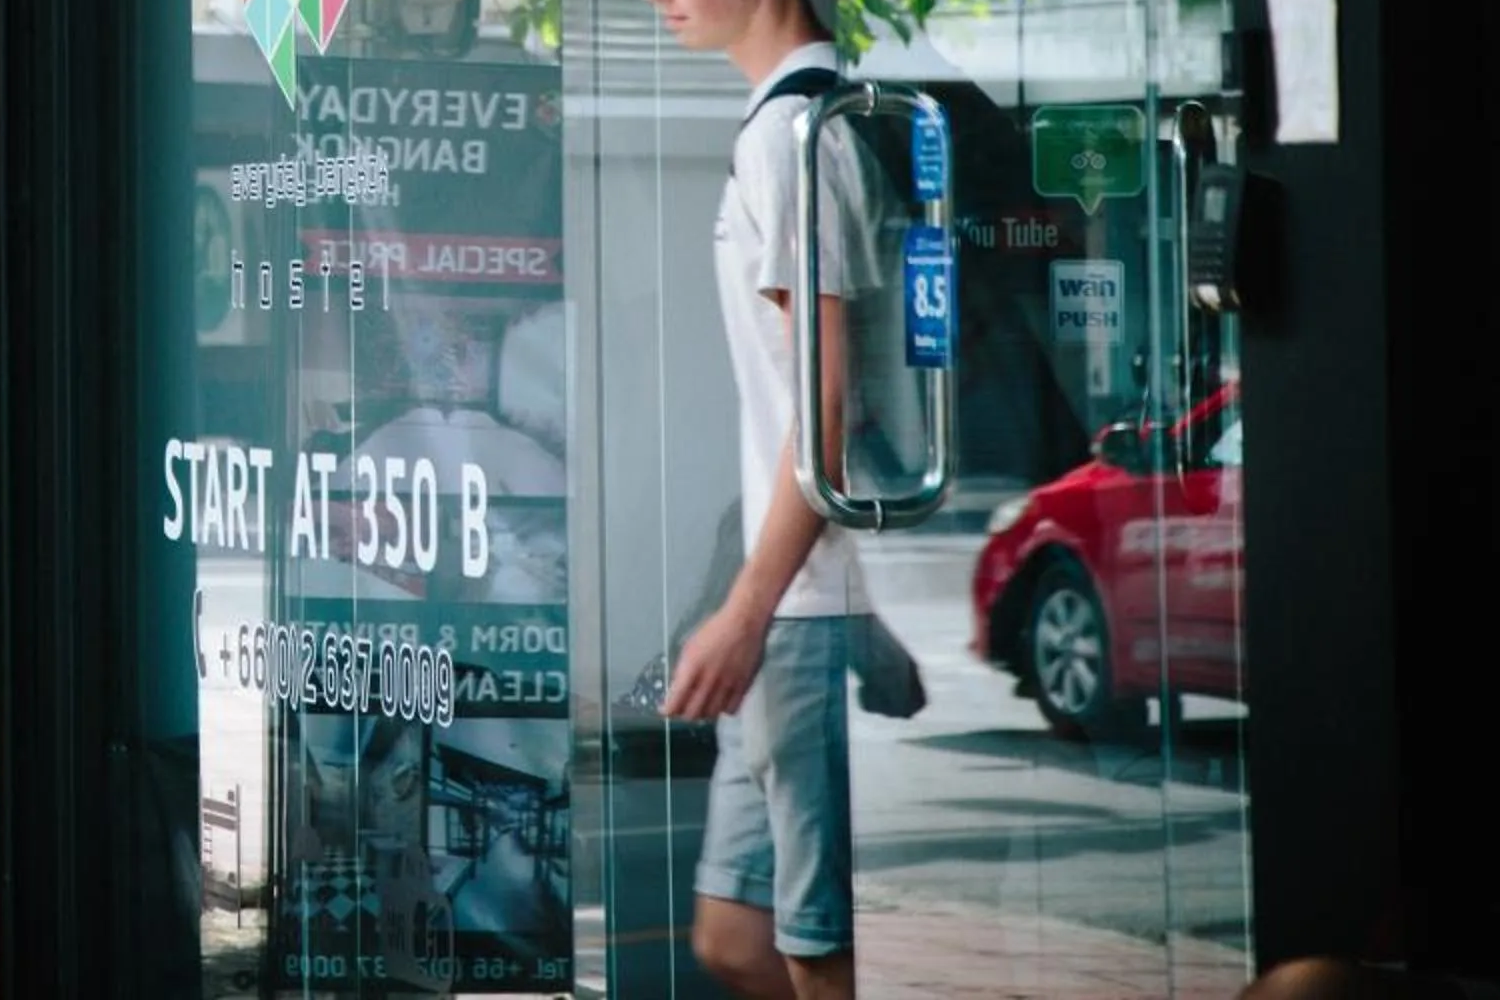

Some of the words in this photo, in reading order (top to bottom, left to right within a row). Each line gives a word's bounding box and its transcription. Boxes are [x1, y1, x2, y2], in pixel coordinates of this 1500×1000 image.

[1001, 215, 1060, 248] Tube
[1058, 311, 1118, 328] PUSH
[164, 439, 273, 552] START
[291, 452, 336, 560] AT
[357, 455, 438, 572] 350
[462, 463, 489, 578] B
[323, 633, 373, 713] 637
[381, 641, 454, 728] 0009
